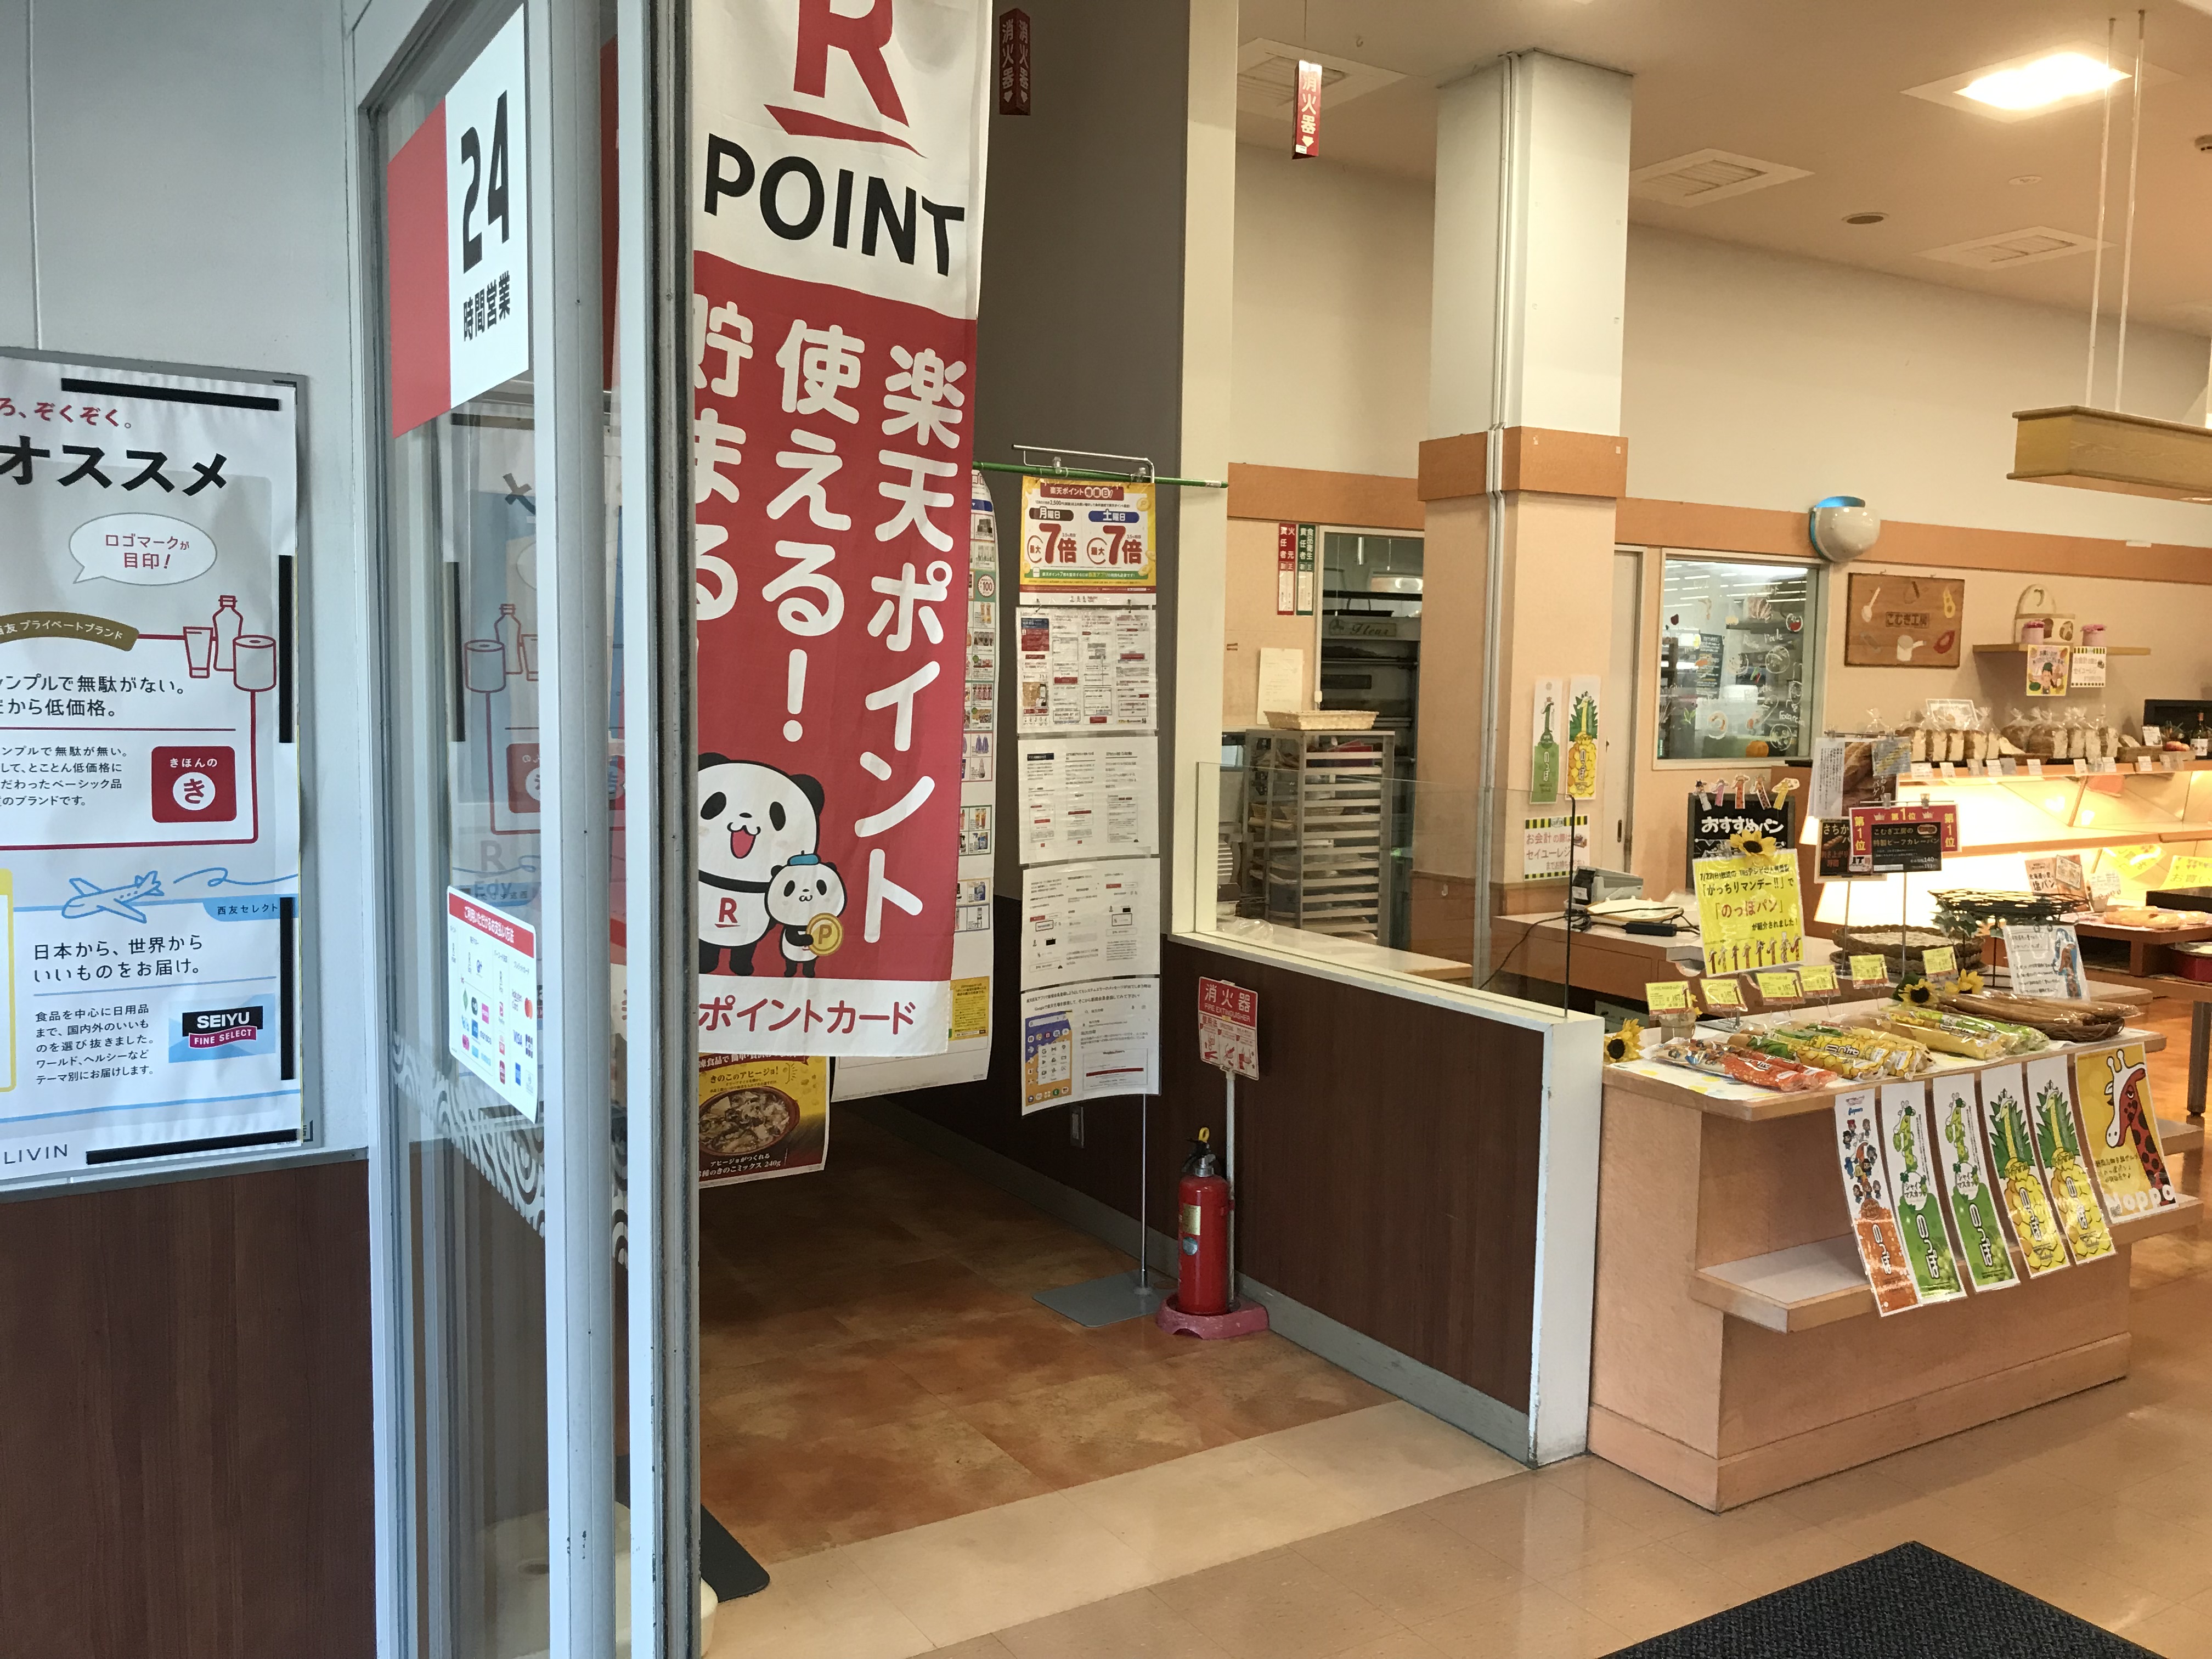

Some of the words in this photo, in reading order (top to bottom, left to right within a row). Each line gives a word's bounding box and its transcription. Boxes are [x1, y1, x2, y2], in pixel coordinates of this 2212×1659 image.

[1002, 19, 1014, 89] 消火器
[1020, 20, 1029, 89] 消火器
[1301, 71, 1317, 134] 消火器
[461, 89, 510, 274] 24
[704, 133, 964, 277] POINT
[462, 271, 511, 342] 時間営業
[0, 435, 227, 496] オススメ
[1039, 506, 1060, 520] 月曜日
[1103, 509, 1126, 521] 土曜日
[105, 533, 190, 550] ロゴマークが
[1039, 522, 1077, 564] 7倍
[1103, 525, 1143, 565] 7倍
[1288, 527, 1295, 559] 火元
[123, 553, 171, 569] 目印!
[20, 619, 123, 640] プライベートブランド
[854, 348, 968, 943] 楽天ポイント
[0, 673, 184, 695] ンプルで無駄がない。
[0, 698, 115, 717] から低価格。
[2, 745, 127, 757] ンプルで無駄が無い。
[1, 763, 122, 774] して、とことん低価格に
[170, 758, 218, 768] きほんの
[1, 778, 122, 789] だわったベーシック品
[183, 778, 205, 804] き
[0, 795, 86, 806] のブランドです。
[1892, 808, 1916, 821] 第1位
[1701, 816, 1785, 834] おすすめパン
[1854, 816, 1866, 850] 第1位
[1874, 827, 1914, 836] こむぎ工房の
[1944, 813, 1955, 847] 第1位
[1526, 832, 1571, 845] お会計の際は
[1526, 847, 1571, 860] セイユーレジ
[217, 904, 278, 916] 西友セレクト
[719, 897, 738, 923] R
[818, 924, 832, 944] P
[35, 934, 202, 960] 日本から、世界から
[34, 958, 200, 983] いいものをお届け。
[1204, 983, 1251, 1013] 消火器
[35, 1003, 149, 1023] 食品を中心に日用品
[196, 1012, 250, 1029] SEIYU
[698, 994, 916, 1035] ポイントカード
[1204, 1002, 1215, 1012] FIRE
[1216, 1006, 1251, 1023] EXTINGUISHER
[36, 1019, 149, 1038] まで、国内外のいいも
[194, 1036, 215, 1045] FINE
[218, 1029, 252, 1042] SELECT
[36, 1034, 154, 1053] のを選び抜きました。
[36, 1049, 149, 1069] ワールド、ヘルシーなど
[36, 1064, 154, 1085] テーマ別にお届けします。
[710, 1066, 779, 1084] きのこのアヒージョ!
[3, 1145, 69, 1165] LIVIN
[710, 1154, 770, 1167] アヒージョがつくれる
[764, 1159, 782, 1167] 240g
[1969, 1203, 1994, 1267] のっぽ
[1916, 1214, 1940, 1279] のっぽ
